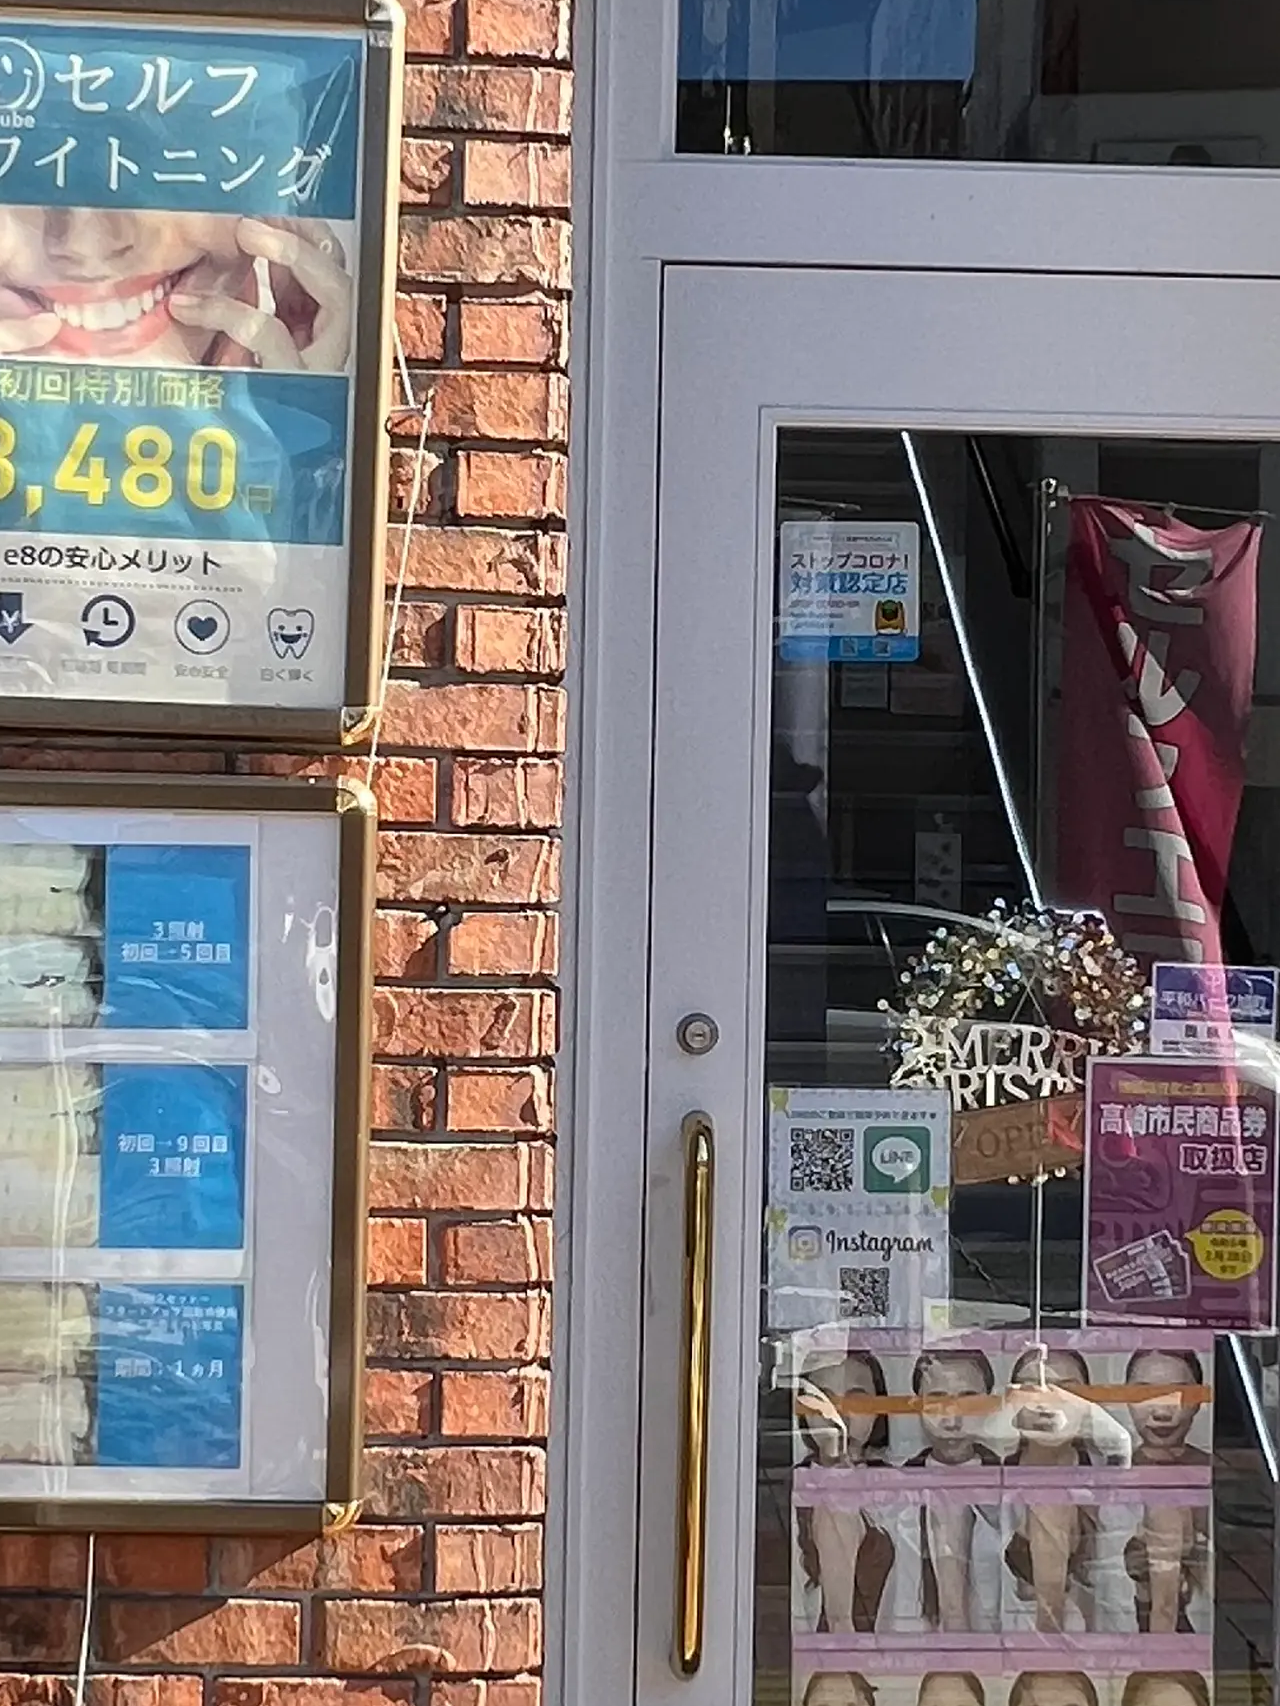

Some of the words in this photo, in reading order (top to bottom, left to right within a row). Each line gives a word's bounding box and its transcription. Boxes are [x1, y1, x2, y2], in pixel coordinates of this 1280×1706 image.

[55, 54, 259, 117] セルフ
[4, 545, 221, 575] e8の安心メリット
[1100, 1102, 1267, 1137] 高崎市民商品券
[880, 1150, 915, 1164] LINE
[1180, 1144, 1267, 1174] 取扱店
[826, 1230, 934, 1261] Instagram
